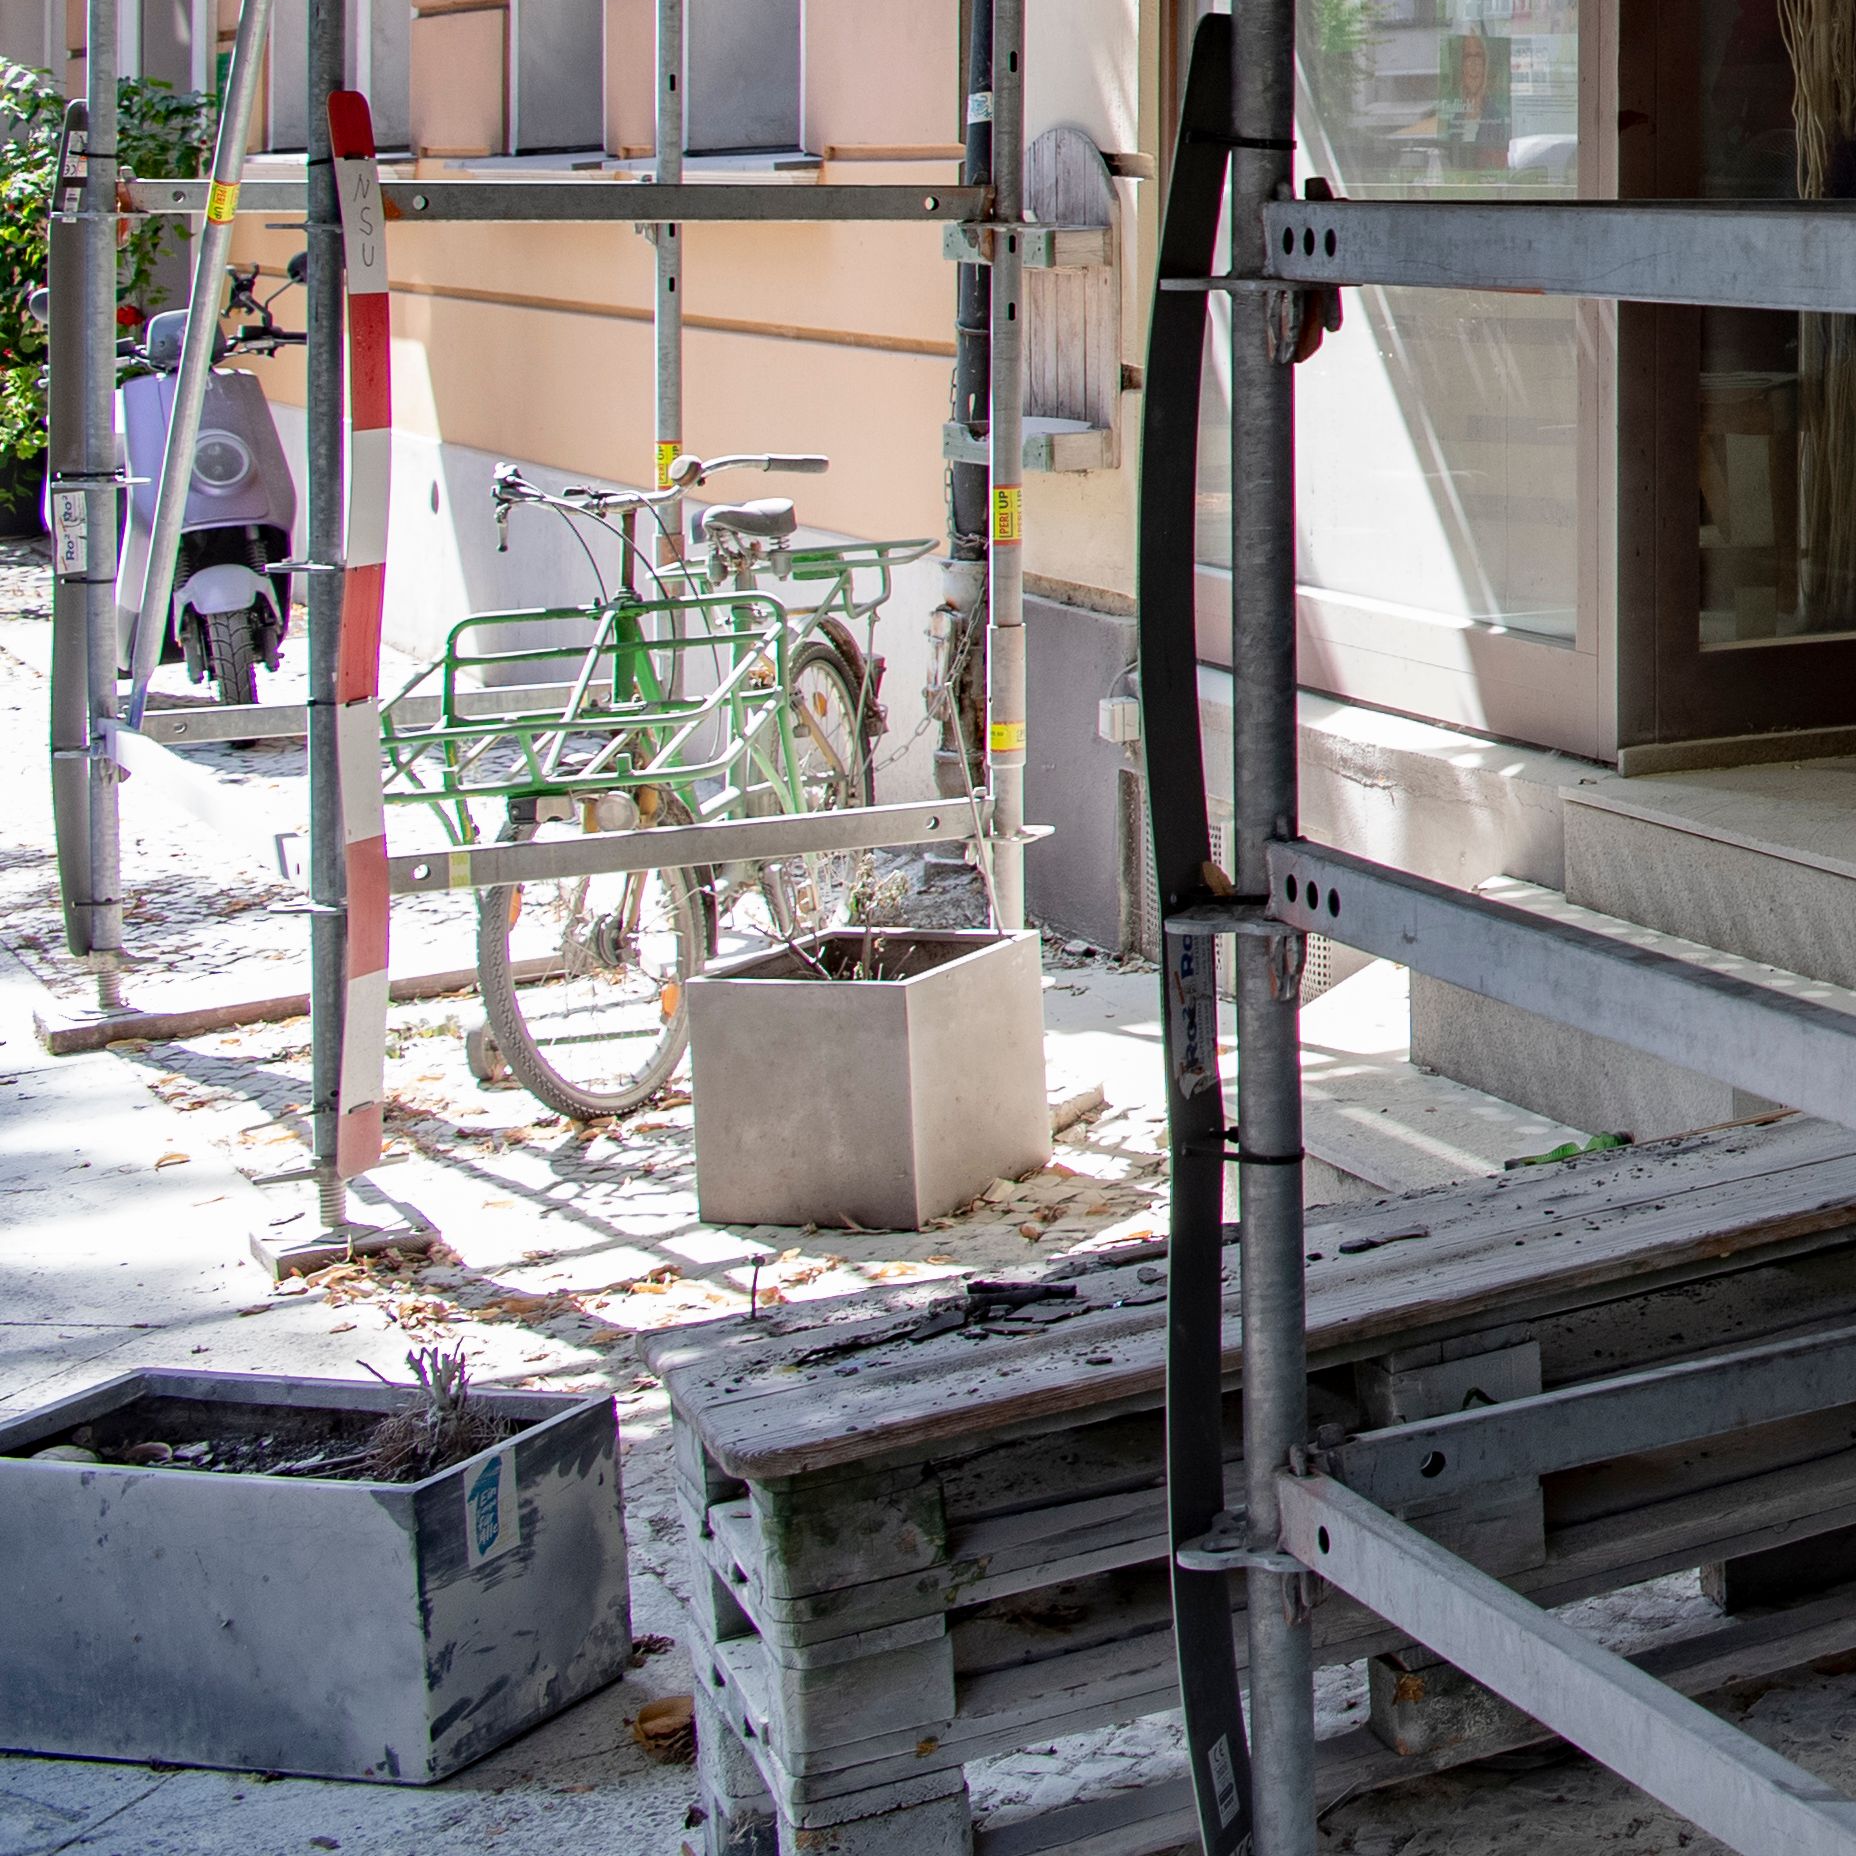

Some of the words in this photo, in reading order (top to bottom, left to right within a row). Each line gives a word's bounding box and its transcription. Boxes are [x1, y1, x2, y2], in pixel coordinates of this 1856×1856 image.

[353, 173, 375, 268] NSU
[998, 490, 1009, 509] UP
[998, 512, 1009, 535] PERI
